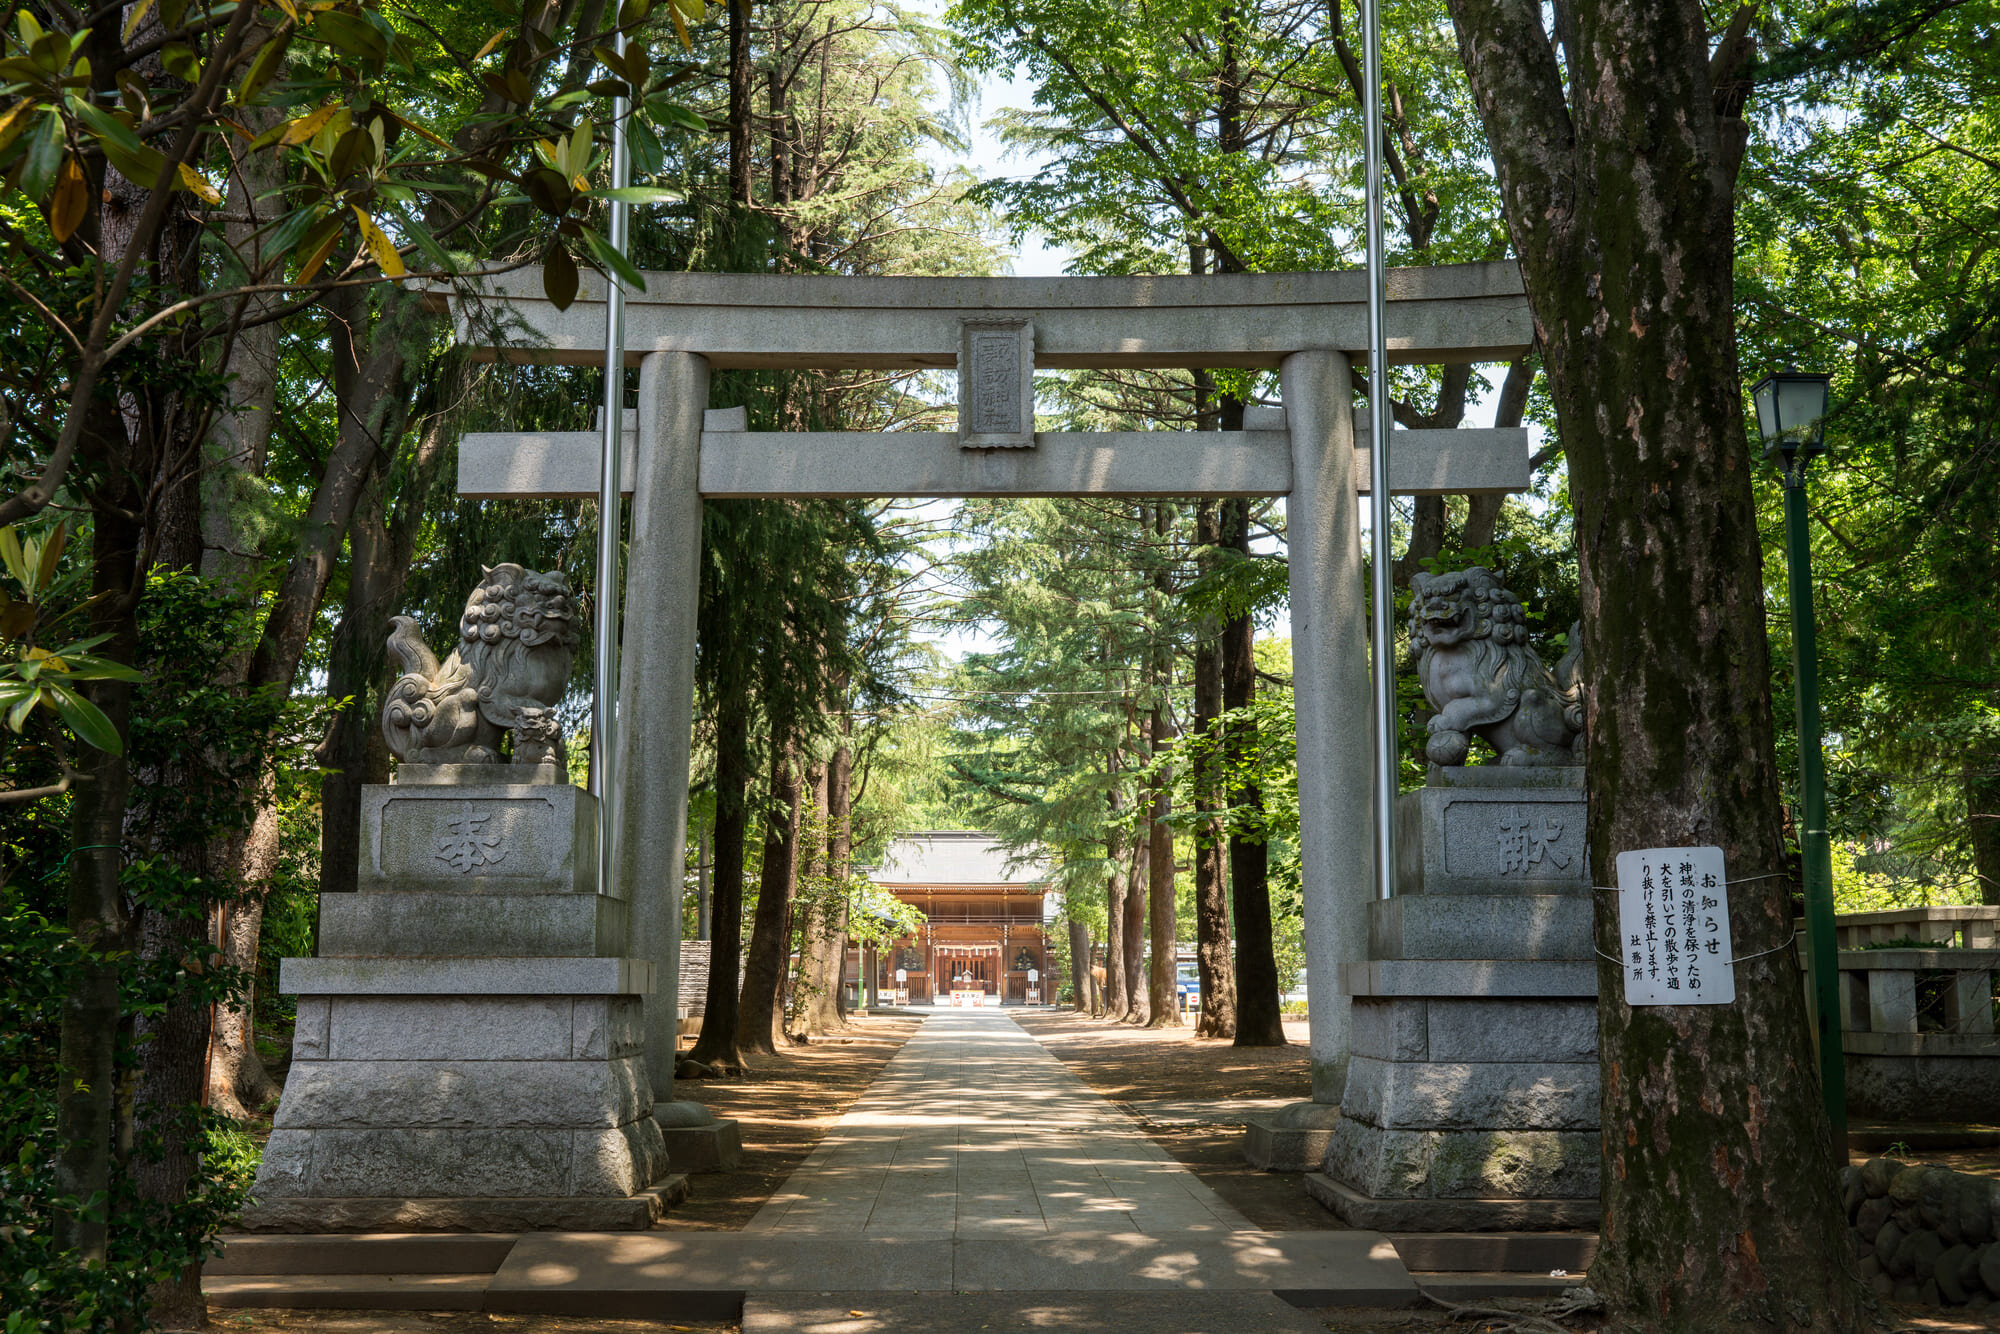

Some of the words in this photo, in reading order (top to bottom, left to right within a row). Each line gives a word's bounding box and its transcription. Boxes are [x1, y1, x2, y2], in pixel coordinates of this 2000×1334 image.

[435, 800, 509, 873] 奉
[1498, 805, 1572, 876] 献
[1642, 865, 1661, 983] り抜けを禁止します。
[1660, 862, 1681, 990] 犬を引いての散歩や通
[1678, 862, 1702, 990] 神域の清浄を保つため
[1700, 873, 1721, 955] お知らせ
[1630, 935, 1643, 981] 社務所
